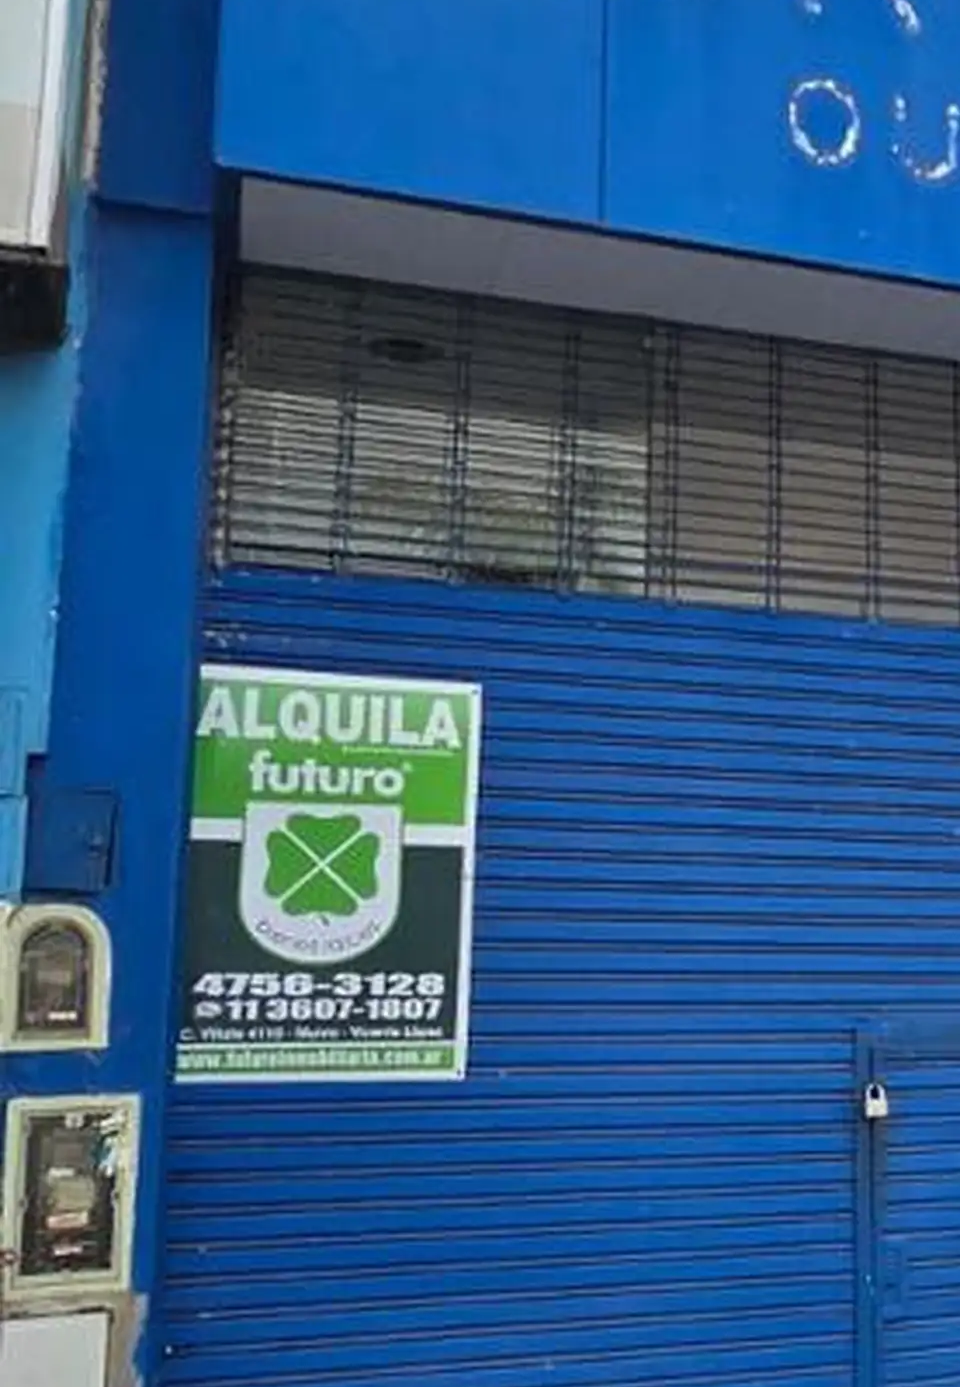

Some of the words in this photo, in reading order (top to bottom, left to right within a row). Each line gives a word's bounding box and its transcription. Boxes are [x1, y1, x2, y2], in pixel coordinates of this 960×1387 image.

[196, 685, 461, 748] ALQUILA
[249, 750, 404, 796] futuro
[192, 972, 445, 996] 4756-3128
[224, 998, 259, 1020] 11
